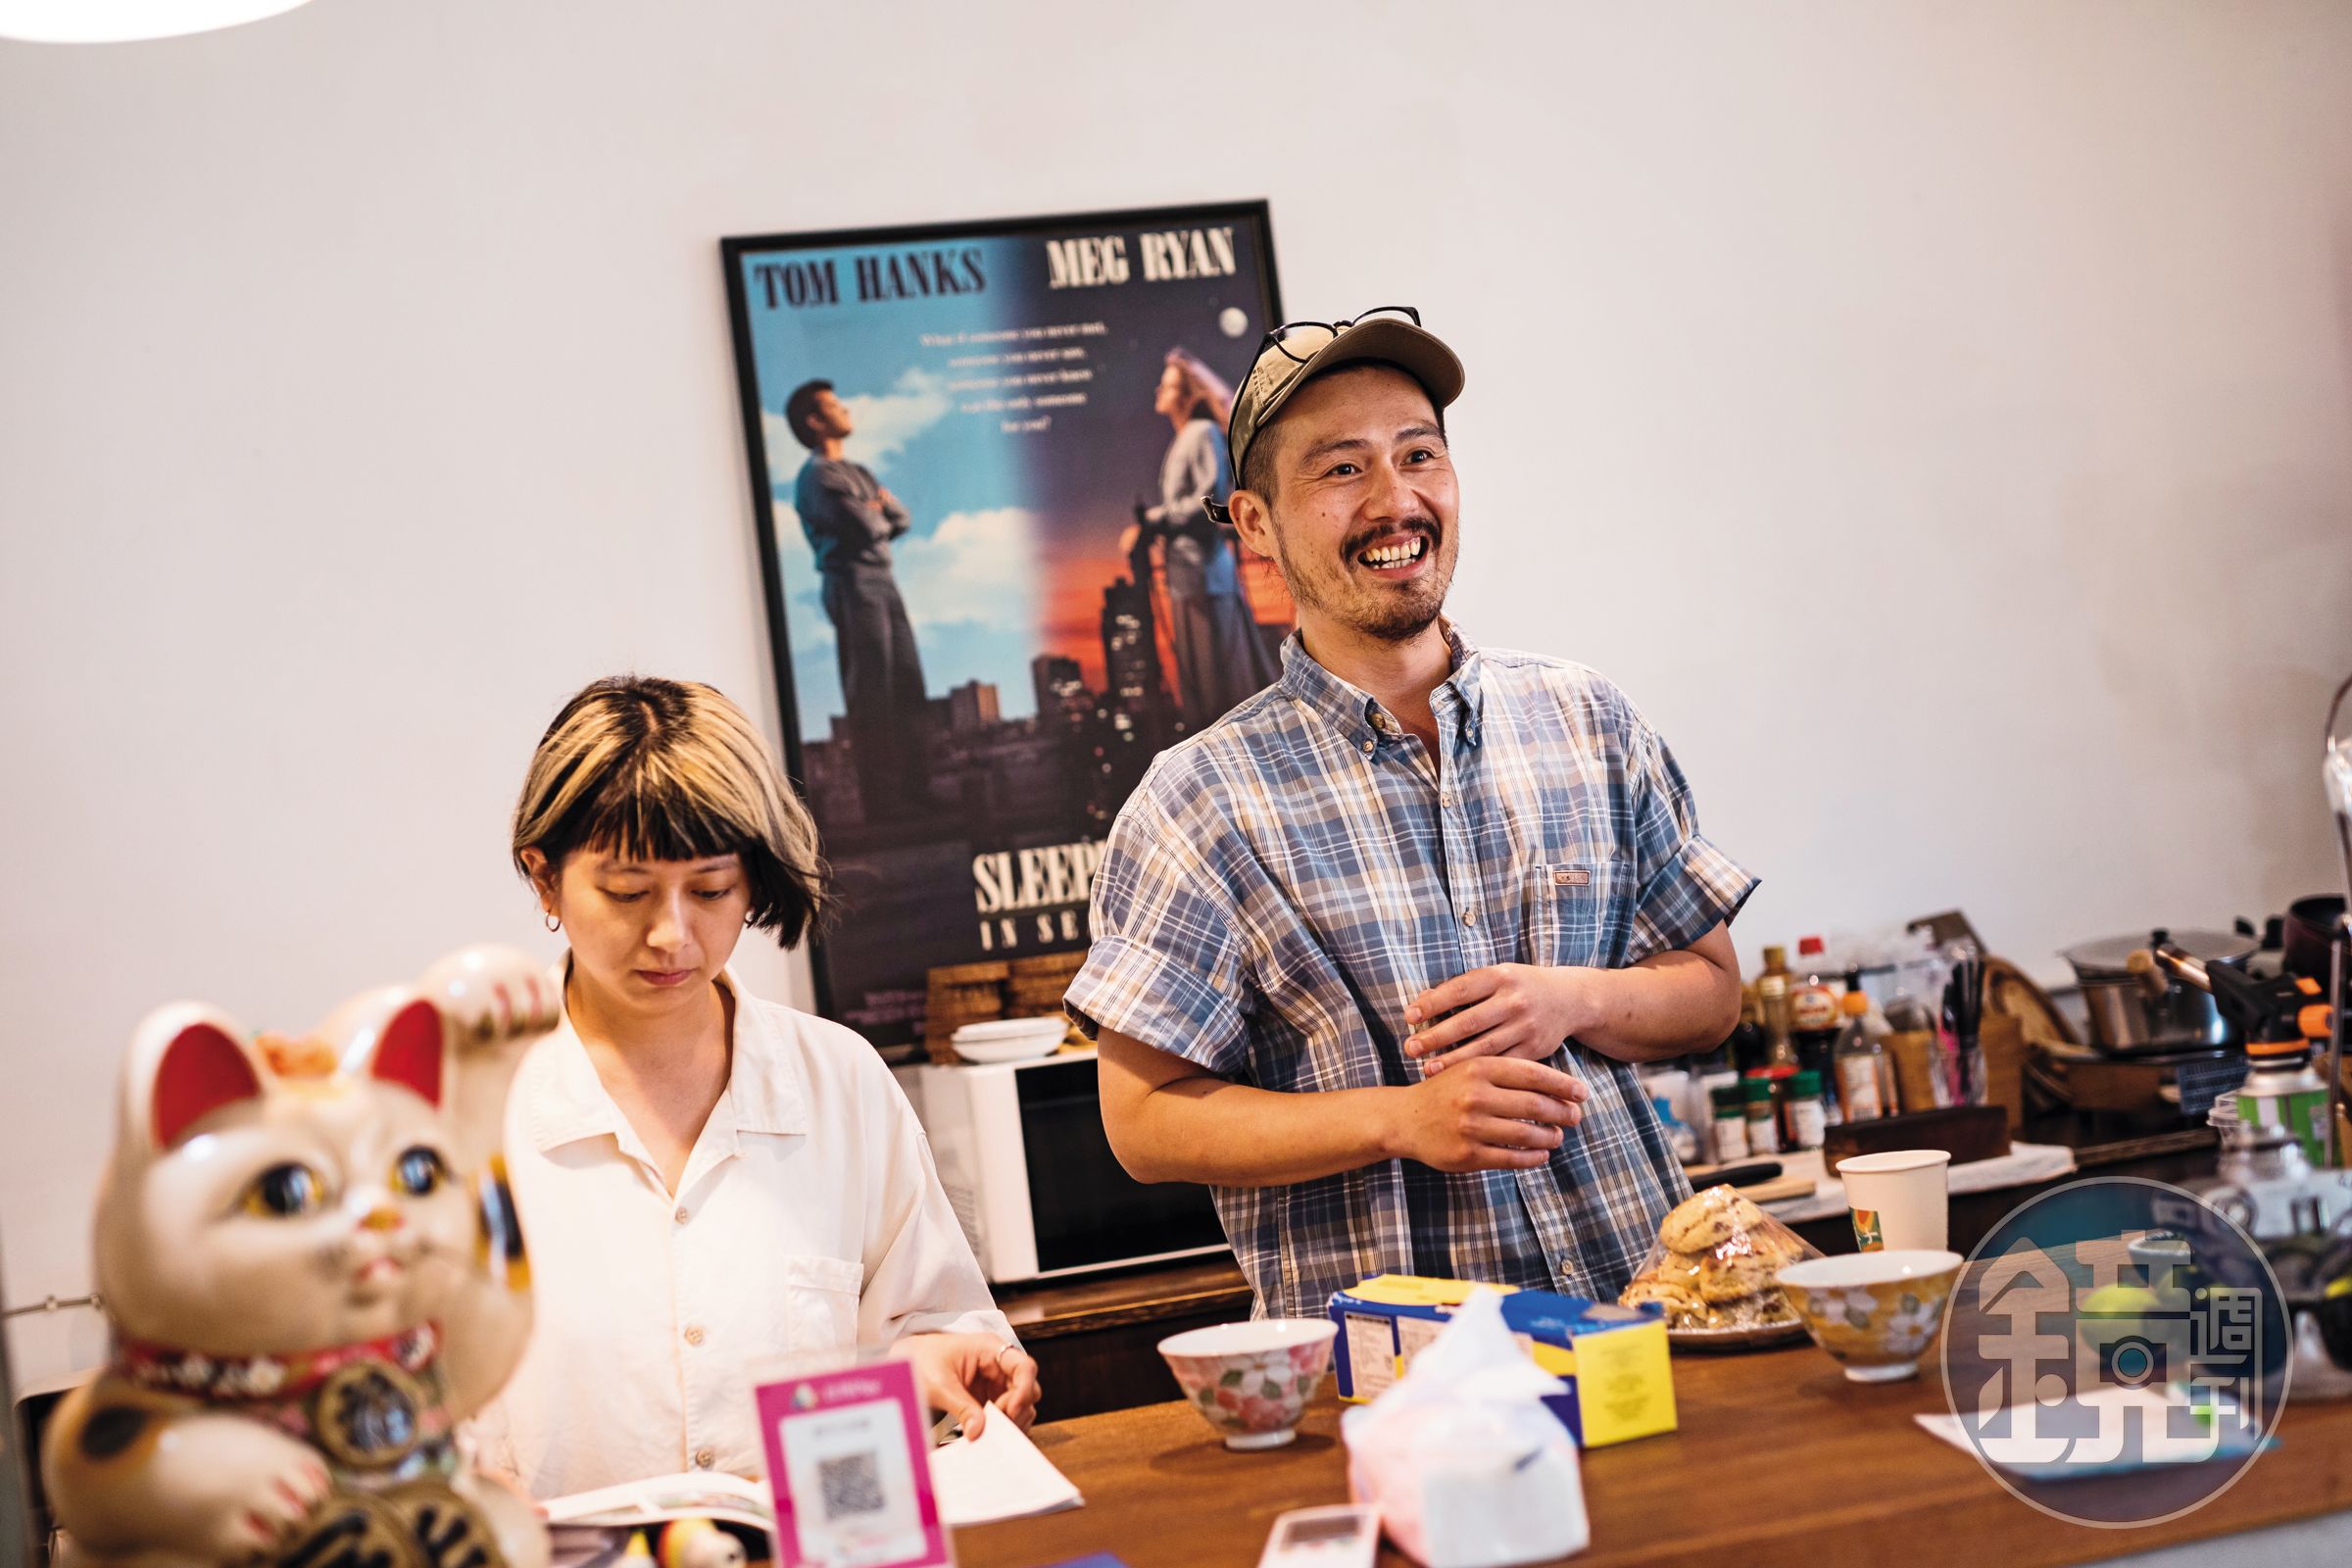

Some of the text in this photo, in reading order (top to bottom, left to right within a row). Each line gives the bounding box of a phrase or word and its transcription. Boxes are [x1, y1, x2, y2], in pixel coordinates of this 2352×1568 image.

[754, 247, 986, 310] TOM HANKS
[1046, 226, 1237, 289] MEG RYAN
[980, 909, 1090, 952] IN SE
